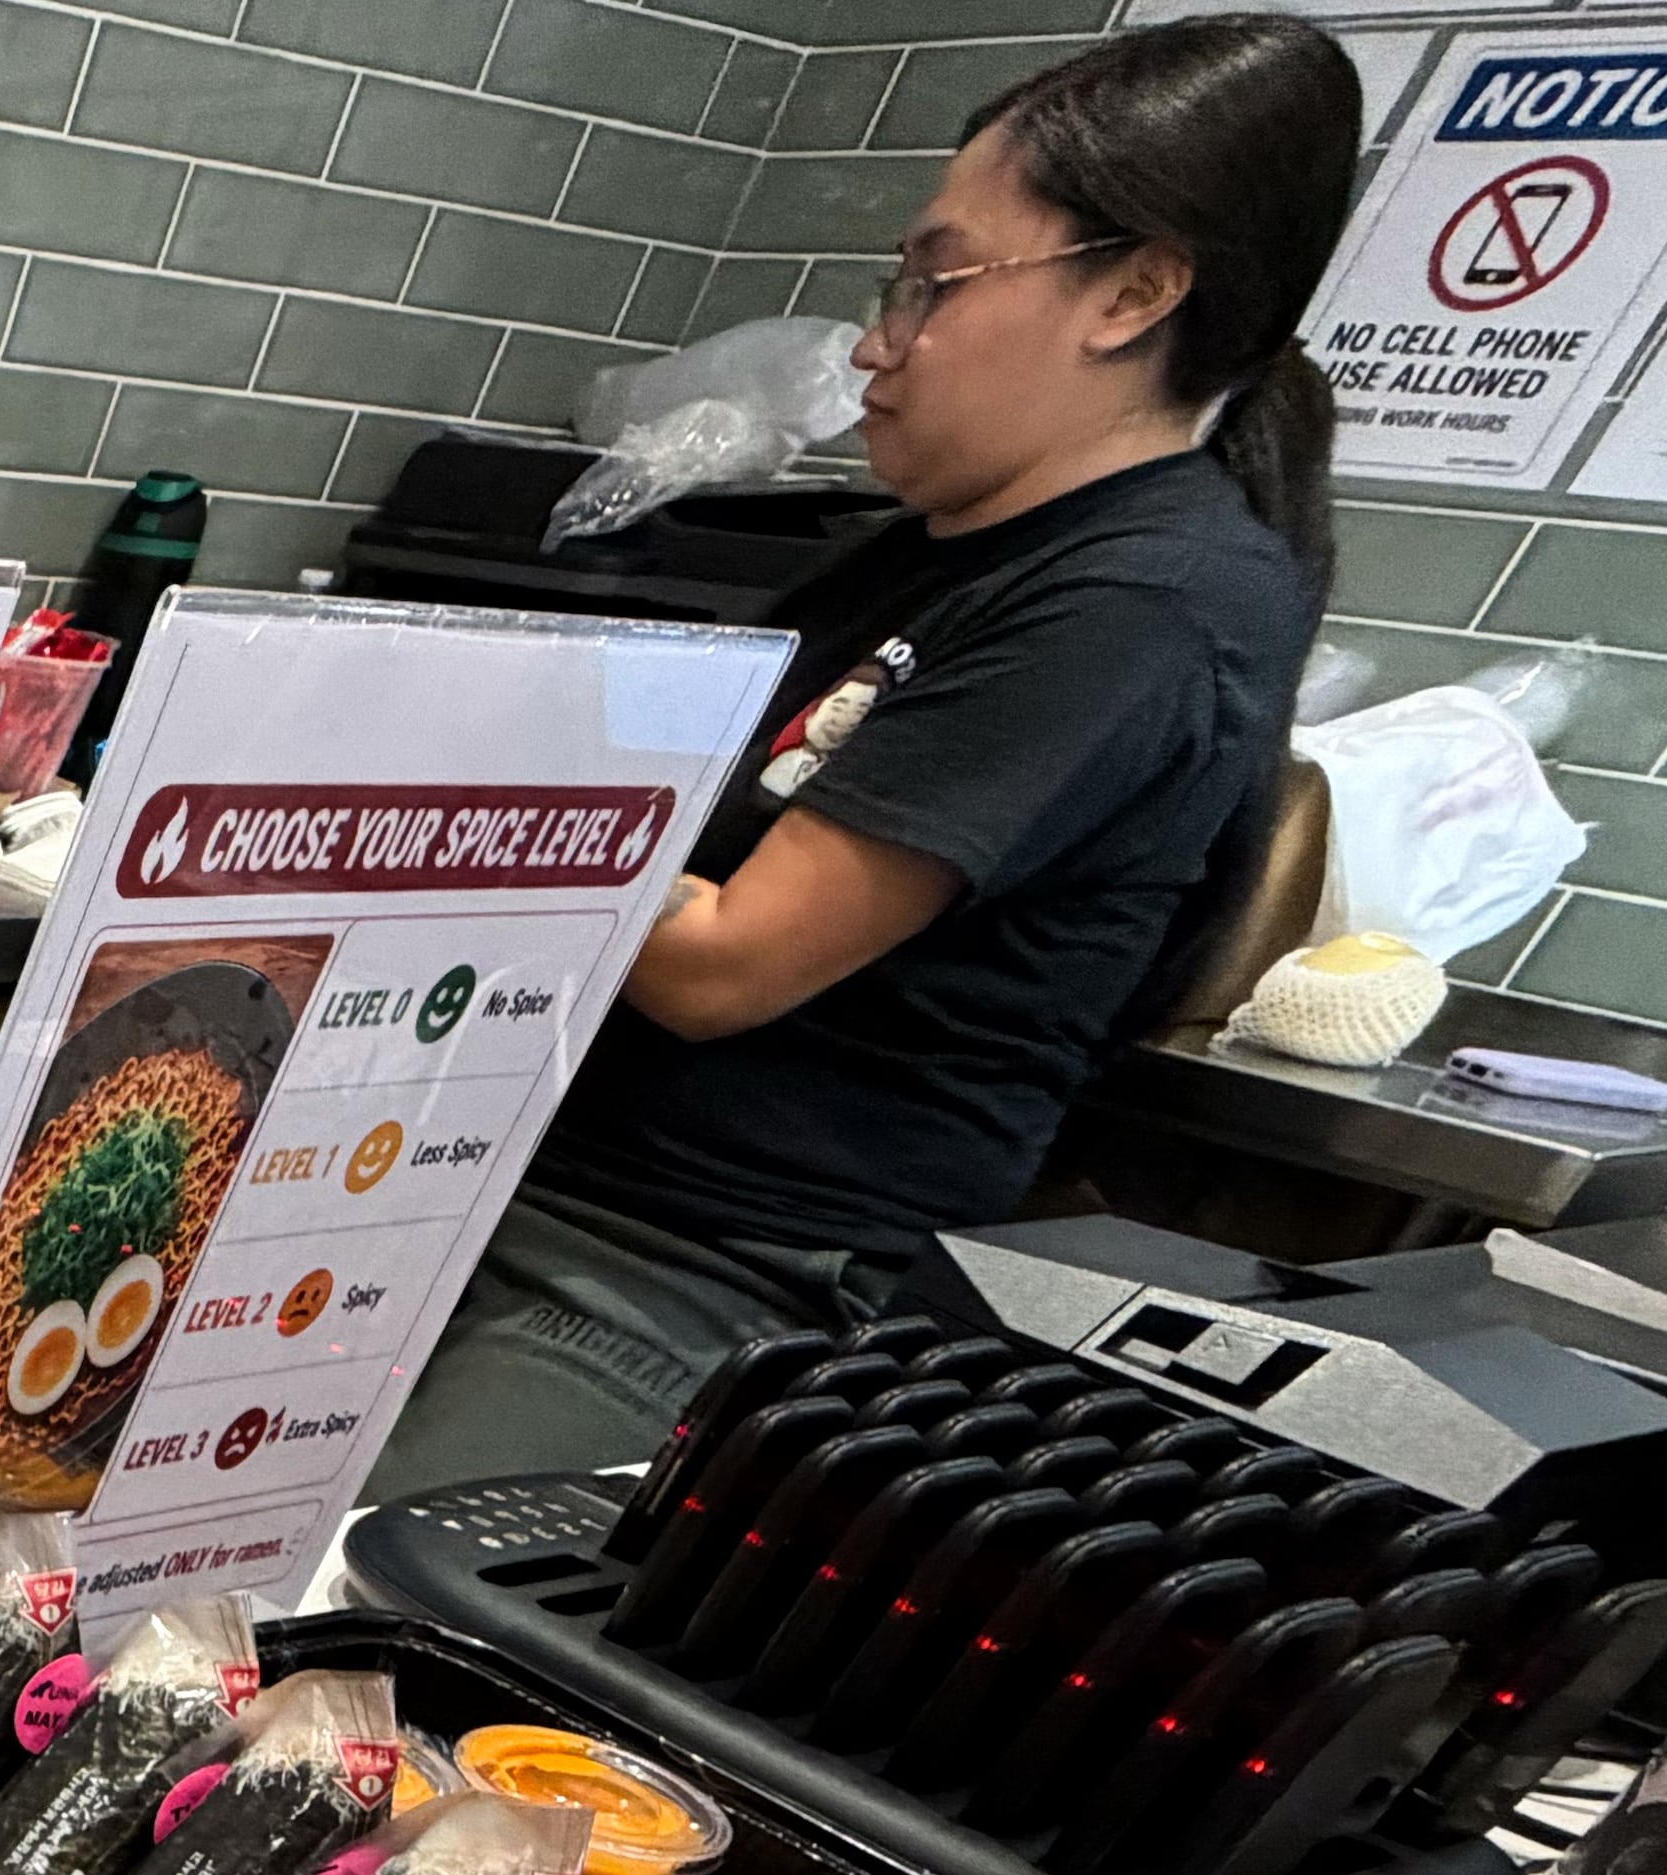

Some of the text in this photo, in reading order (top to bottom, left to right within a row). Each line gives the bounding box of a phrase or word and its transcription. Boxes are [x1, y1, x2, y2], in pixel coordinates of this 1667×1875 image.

[1456, 67, 1667, 130] NOTIC
[1326, 322, 1591, 362] NO CELL PHONE
[1324, 361, 1550, 400] USE ALLOWED
[1379, 407, 1511, 434] WORK HOURS
[200, 805, 625, 873] CHOOSE YOUR SPICE LEVEL
[318, 986, 553, 1030] LEVEL 0 No Spice
[249, 1136, 492, 1185] LEVEL 1 Less Spicy
[183, 1282, 387, 1333] LEVEL 2 Spicy
[124, 1410, 360, 1471] LEVEL 3 Extra Spicy
[88, 1559, 163, 1597] adjusted
[163, 1546, 208, 1583] ONLY
[208, 1544, 229, 1572] for
[230, 1538, 287, 1569] ramen.
